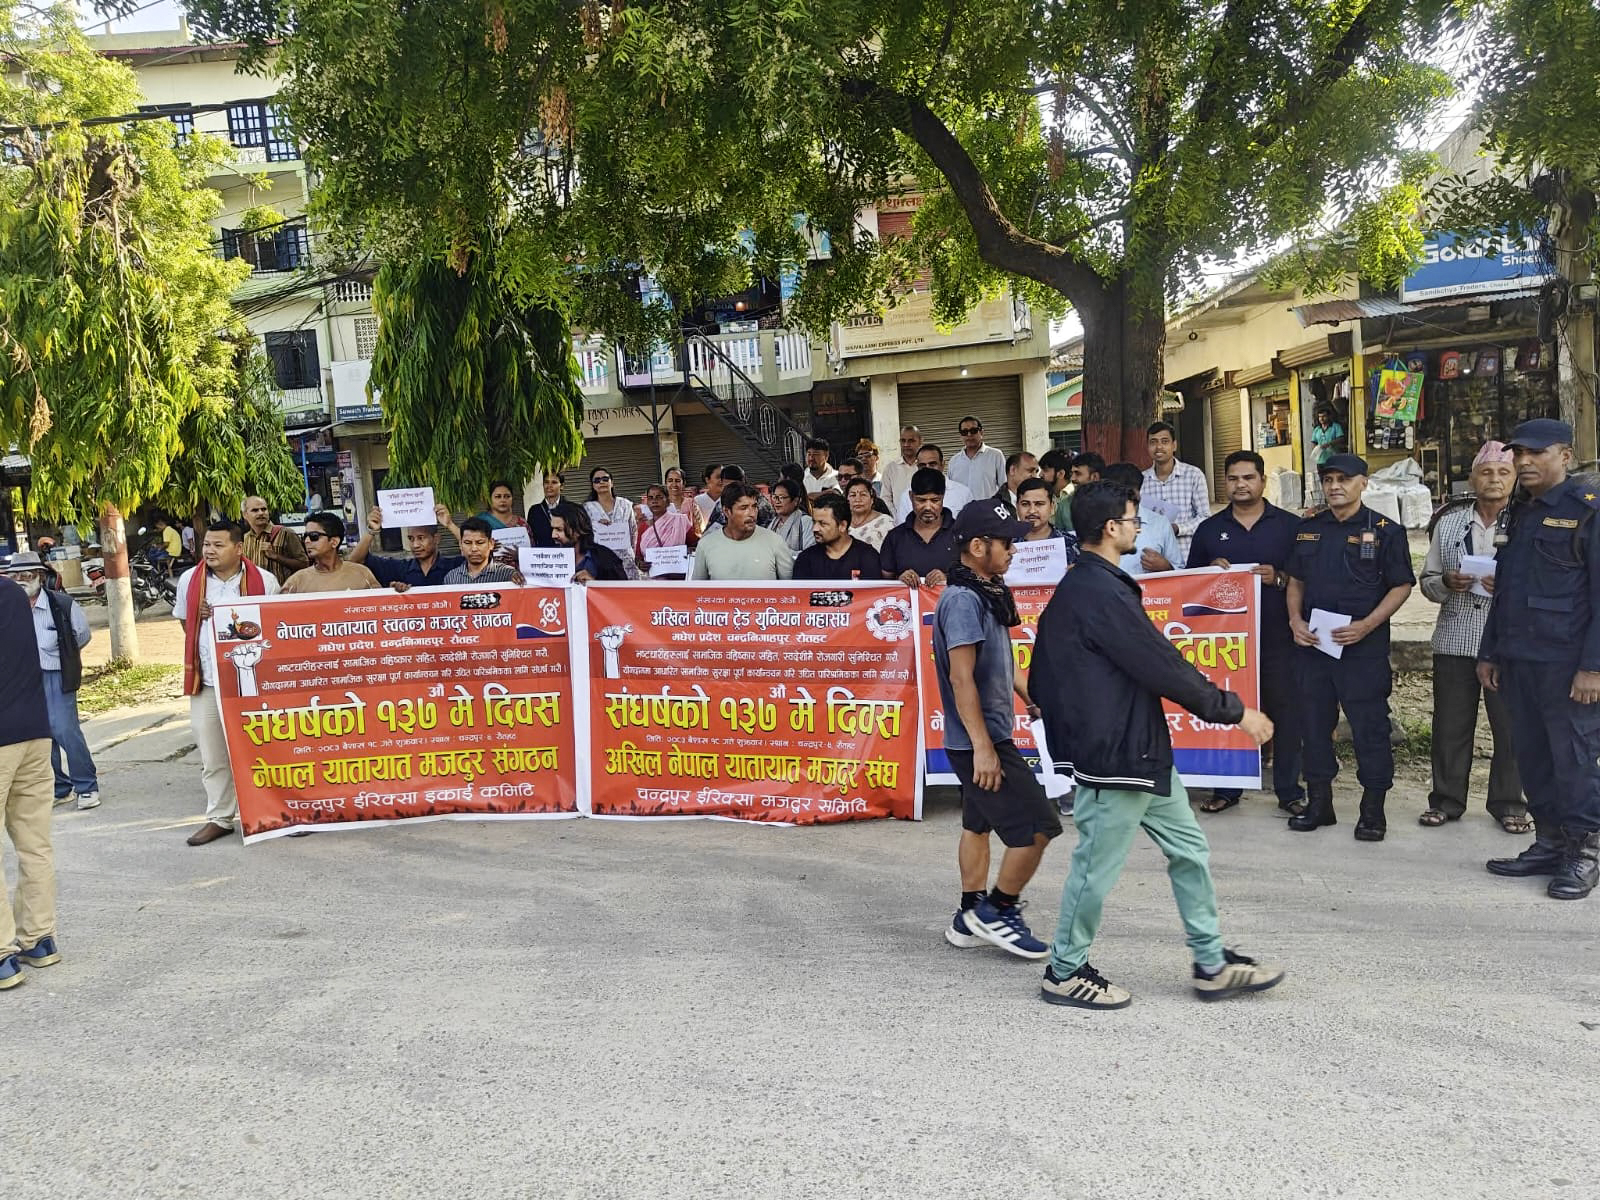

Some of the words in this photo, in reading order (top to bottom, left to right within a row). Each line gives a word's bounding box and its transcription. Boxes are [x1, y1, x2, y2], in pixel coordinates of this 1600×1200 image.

[276, 621, 317, 640] नेपाल
[321, 619, 378, 637] यातायात
[382, 617, 426, 634] स्वतन्त्र
[429, 615, 468, 633] मजदुर
[471, 611, 513, 630] संगठन
[650, 606, 690, 627] अखिल
[694, 607, 729, 627] नेपाल
[732, 607, 751, 630] ट्रेड
[755, 606, 801, 630] युनियन
[805, 609, 851, 629] महासंघ
[342, 656, 377, 668] सामाजिक
[692, 649, 723, 660] सामाजिक
[299, 677, 328, 688] आधारित
[331, 674, 363, 685] सामाजिक
[366, 672, 386, 685] सुरक्षा
[653, 665, 678, 676] आधारित
[712, 667, 730, 680] सुरक्षा
[240, 691, 367, 746] संघर्षको
[376, 697, 439, 734] १३७
[447, 684, 475, 728] मे
[482, 682, 561, 728] दिवस
[604, 684, 711, 730] संघर्षको
[719, 697, 778, 735] १३७
[788, 686, 817, 733] मे
[826, 686, 904, 739] दिवस
[251, 757, 316, 789] नेपाल
[322, 753, 412, 785] यातायात
[418, 748, 486, 783] मजदुर
[490, 743, 559, 774] संगठन
[605, 740, 662, 776] अखिल
[667, 743, 720, 779] नेपाल
[724, 753, 801, 784] यातायात
[807, 756, 861, 795] मजदुर
[864, 754, 900, 789] संघ
[285, 797, 346, 813] चन्द्रपुर
[352, 791, 419, 809] ईरिक्सा
[424, 782, 475, 804] इकाई
[480, 782, 536, 798] कमिटि
[636, 787, 692, 805] चन्द्रपुर
[696, 786, 755, 807] ईरिक्सा
[760, 794, 814, 813] मजदुर
[818, 797, 867, 814] समिति
